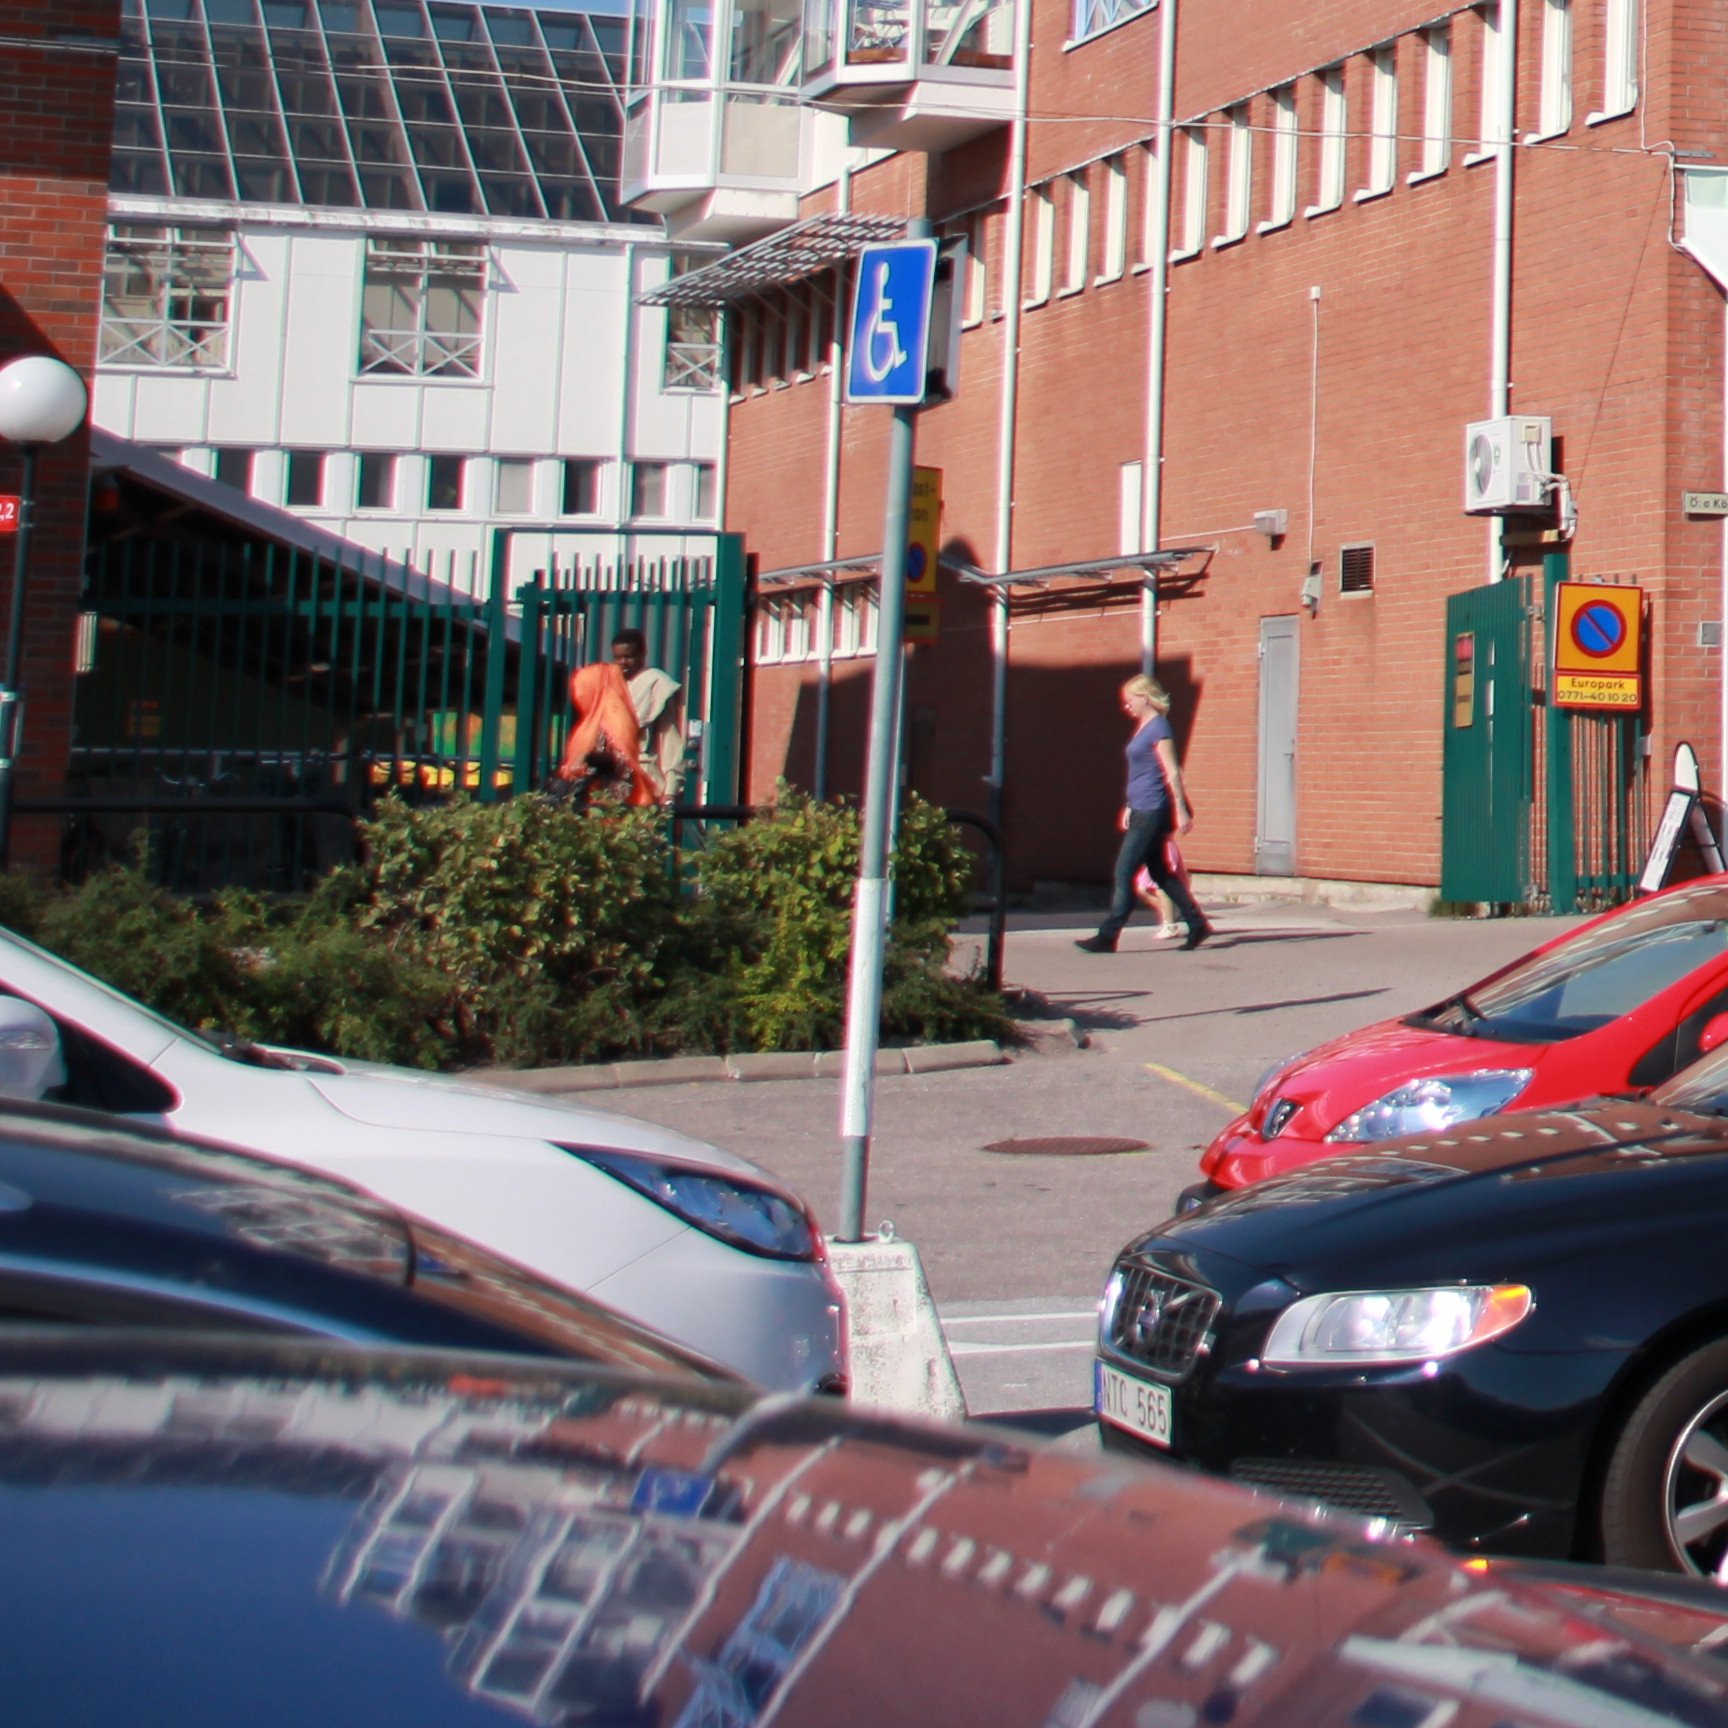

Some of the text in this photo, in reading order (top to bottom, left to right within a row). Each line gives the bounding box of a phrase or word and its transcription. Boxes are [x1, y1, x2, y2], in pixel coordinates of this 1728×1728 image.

[1571, 678, 1626, 690] Europark
[1621, 693, 1637, 703] 20
[1103, 1370, 1167, 1435] NTC 565
